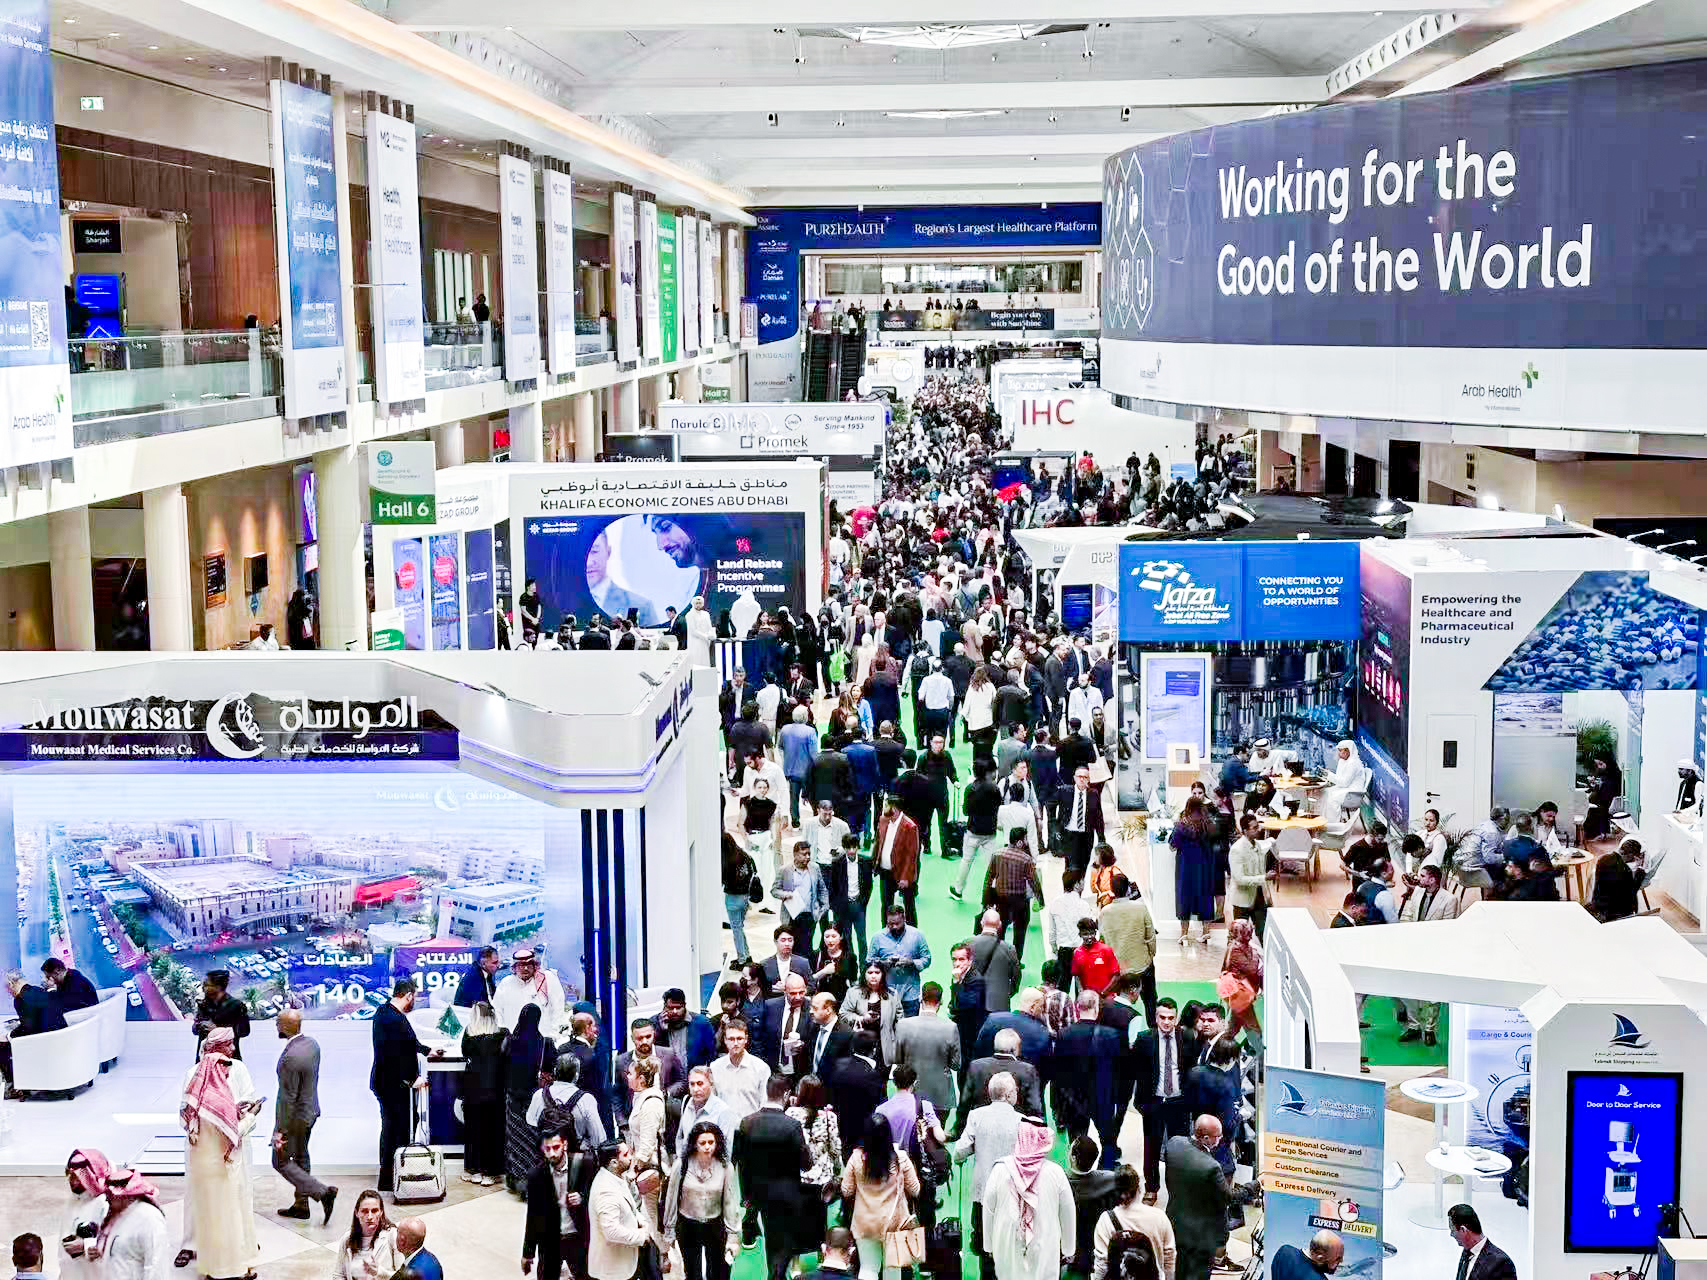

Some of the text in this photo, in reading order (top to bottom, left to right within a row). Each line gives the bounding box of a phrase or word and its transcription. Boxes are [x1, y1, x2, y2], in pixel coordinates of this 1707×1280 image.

[1218, 139, 1516, 225] Working for the
[914, 223, 955, 236] Region's
[957, 223, 996, 235] Largest
[997, 222, 1052, 233] Healthcare
[1054, 220, 1097, 232] Platform
[1217, 223, 1593, 296] Good of the World
[705, 389, 728, 398] Hall 7
[1461, 383, 1522, 399] Arab Health
[813, 414, 875, 423] Serving Mankind
[1022, 399, 1075, 425] IHC
[758, 434, 808, 448] Promek
[540, 478, 788, 497] مناطق خليفة الاقتصادية أبوظبي
[378, 501, 412, 517] Hall
[416, 501, 430, 517] 6
[540, 495, 788, 510] KHALIFA ECONOMIC ZONES ABU DHABI
[440, 505, 480, 519] ZAD GROUP
[716, 559, 783, 569] Land Rebate
[717, 571, 764, 581] Incentive
[1258, 576, 1344, 586] CONNECTING YOU
[717, 583, 786, 594] Programmes
[1263, 586, 1339, 595] TO A WORLD OF
[1153, 583, 1217, 610] Jafza
[1263, 596, 1339, 606] OPPORTUNITIES
[1421, 594, 1522, 606] Empowering the
[1421, 608, 1512, 618] Healthcare and
[1420, 621, 1514, 631] Pharmaceutical
[1420, 635, 1470, 646] Industry
[31, 699, 196, 730] Mouwasat
[279, 695, 419, 739] المواساة
[31, 744, 196, 755] Mouwasat Medical Services Co.
[312, 744, 355, 754] للخدمات
[356, 743, 390, 755] المواساة
[391, 743, 420, 756] شركة
[376, 790, 430, 801] Mouwasat
[303, 953, 373, 967] العيادات
[415, 952, 473, 967] الافتتاح
[411, 971, 465, 992] 198
[315, 983, 365, 1004] 140
[1481, 1031, 1502, 1039] Cargo
[1586, 1100, 1604, 1108] Door
[1614, 1100, 1632, 1108] Door
[1633, 1100, 1662, 1109] Service
[1275, 1136, 1362, 1156] International Courier and
[1275, 1144, 1328, 1159] Cargo Services
[1275, 1162, 1340, 1179] Custom Clearance
[1275, 1180, 1337, 1197] Express Delivery
[1313, 1217, 1374, 1234] EXPRESS DELIVERY
